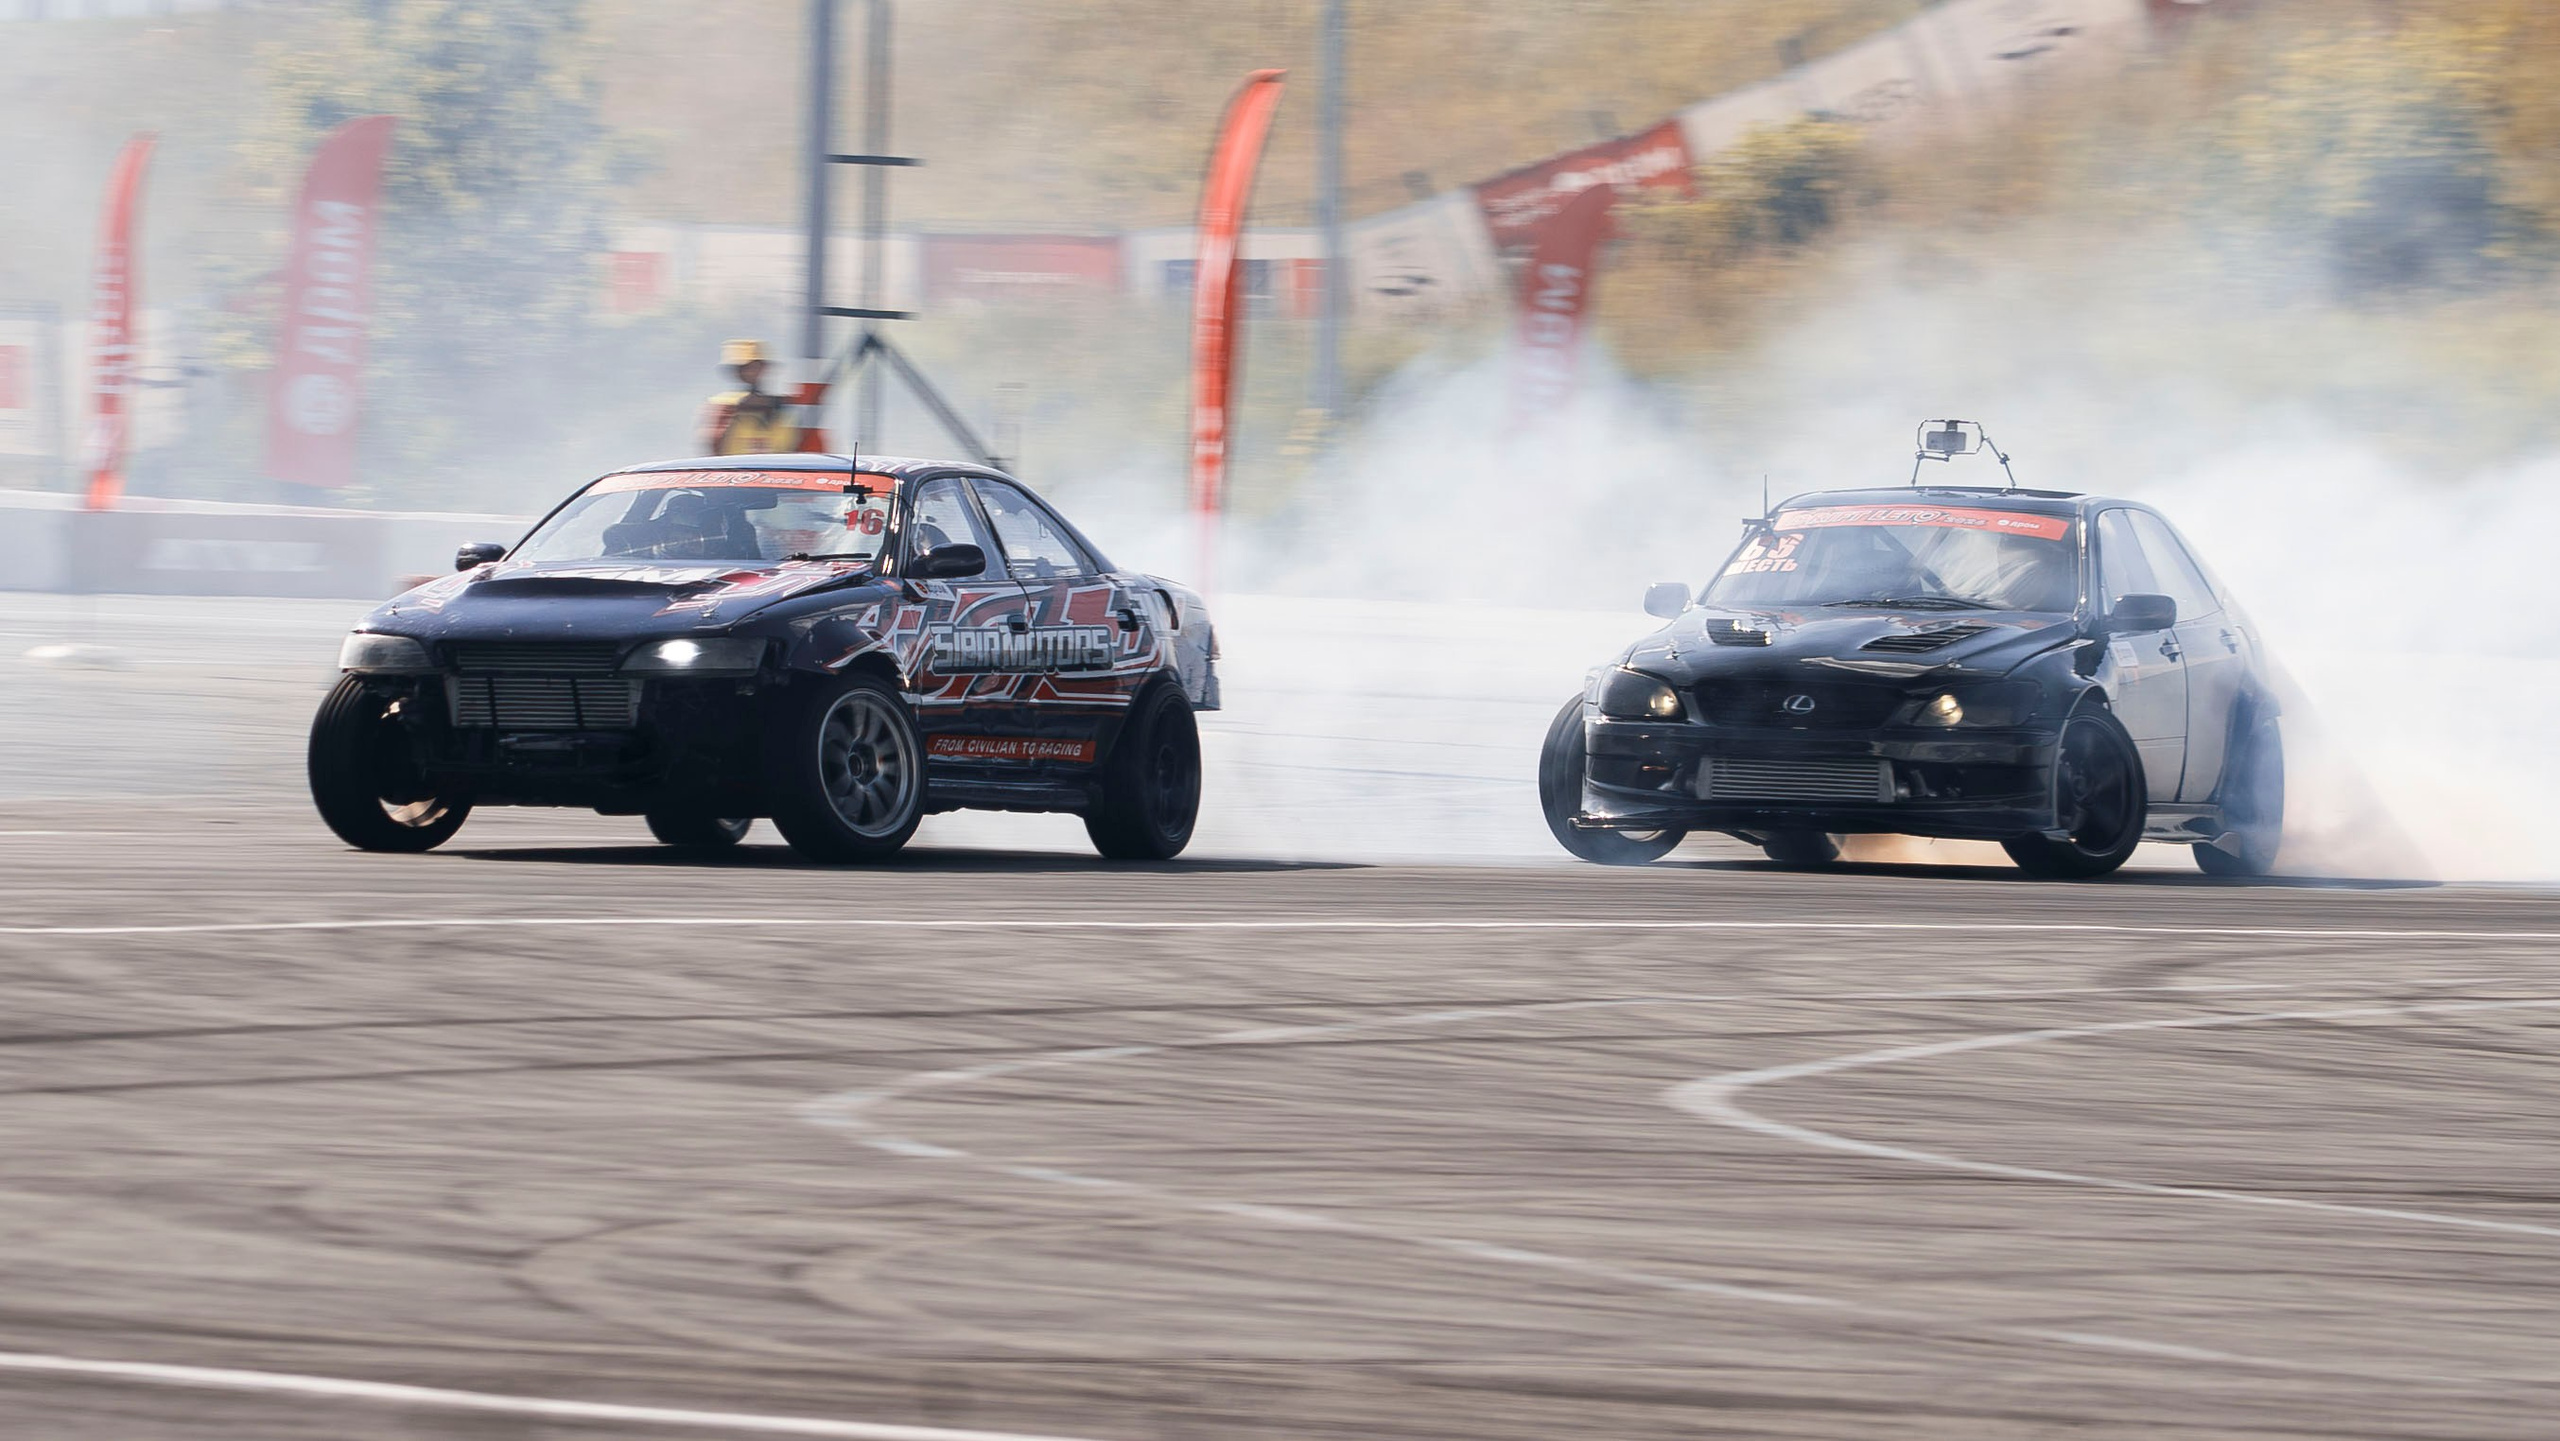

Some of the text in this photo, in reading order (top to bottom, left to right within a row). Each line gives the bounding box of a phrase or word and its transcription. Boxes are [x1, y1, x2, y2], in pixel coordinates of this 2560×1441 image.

[844, 509, 885, 536] 16
[934, 739, 1082, 756] FROM CIVILIAN TO RACING
